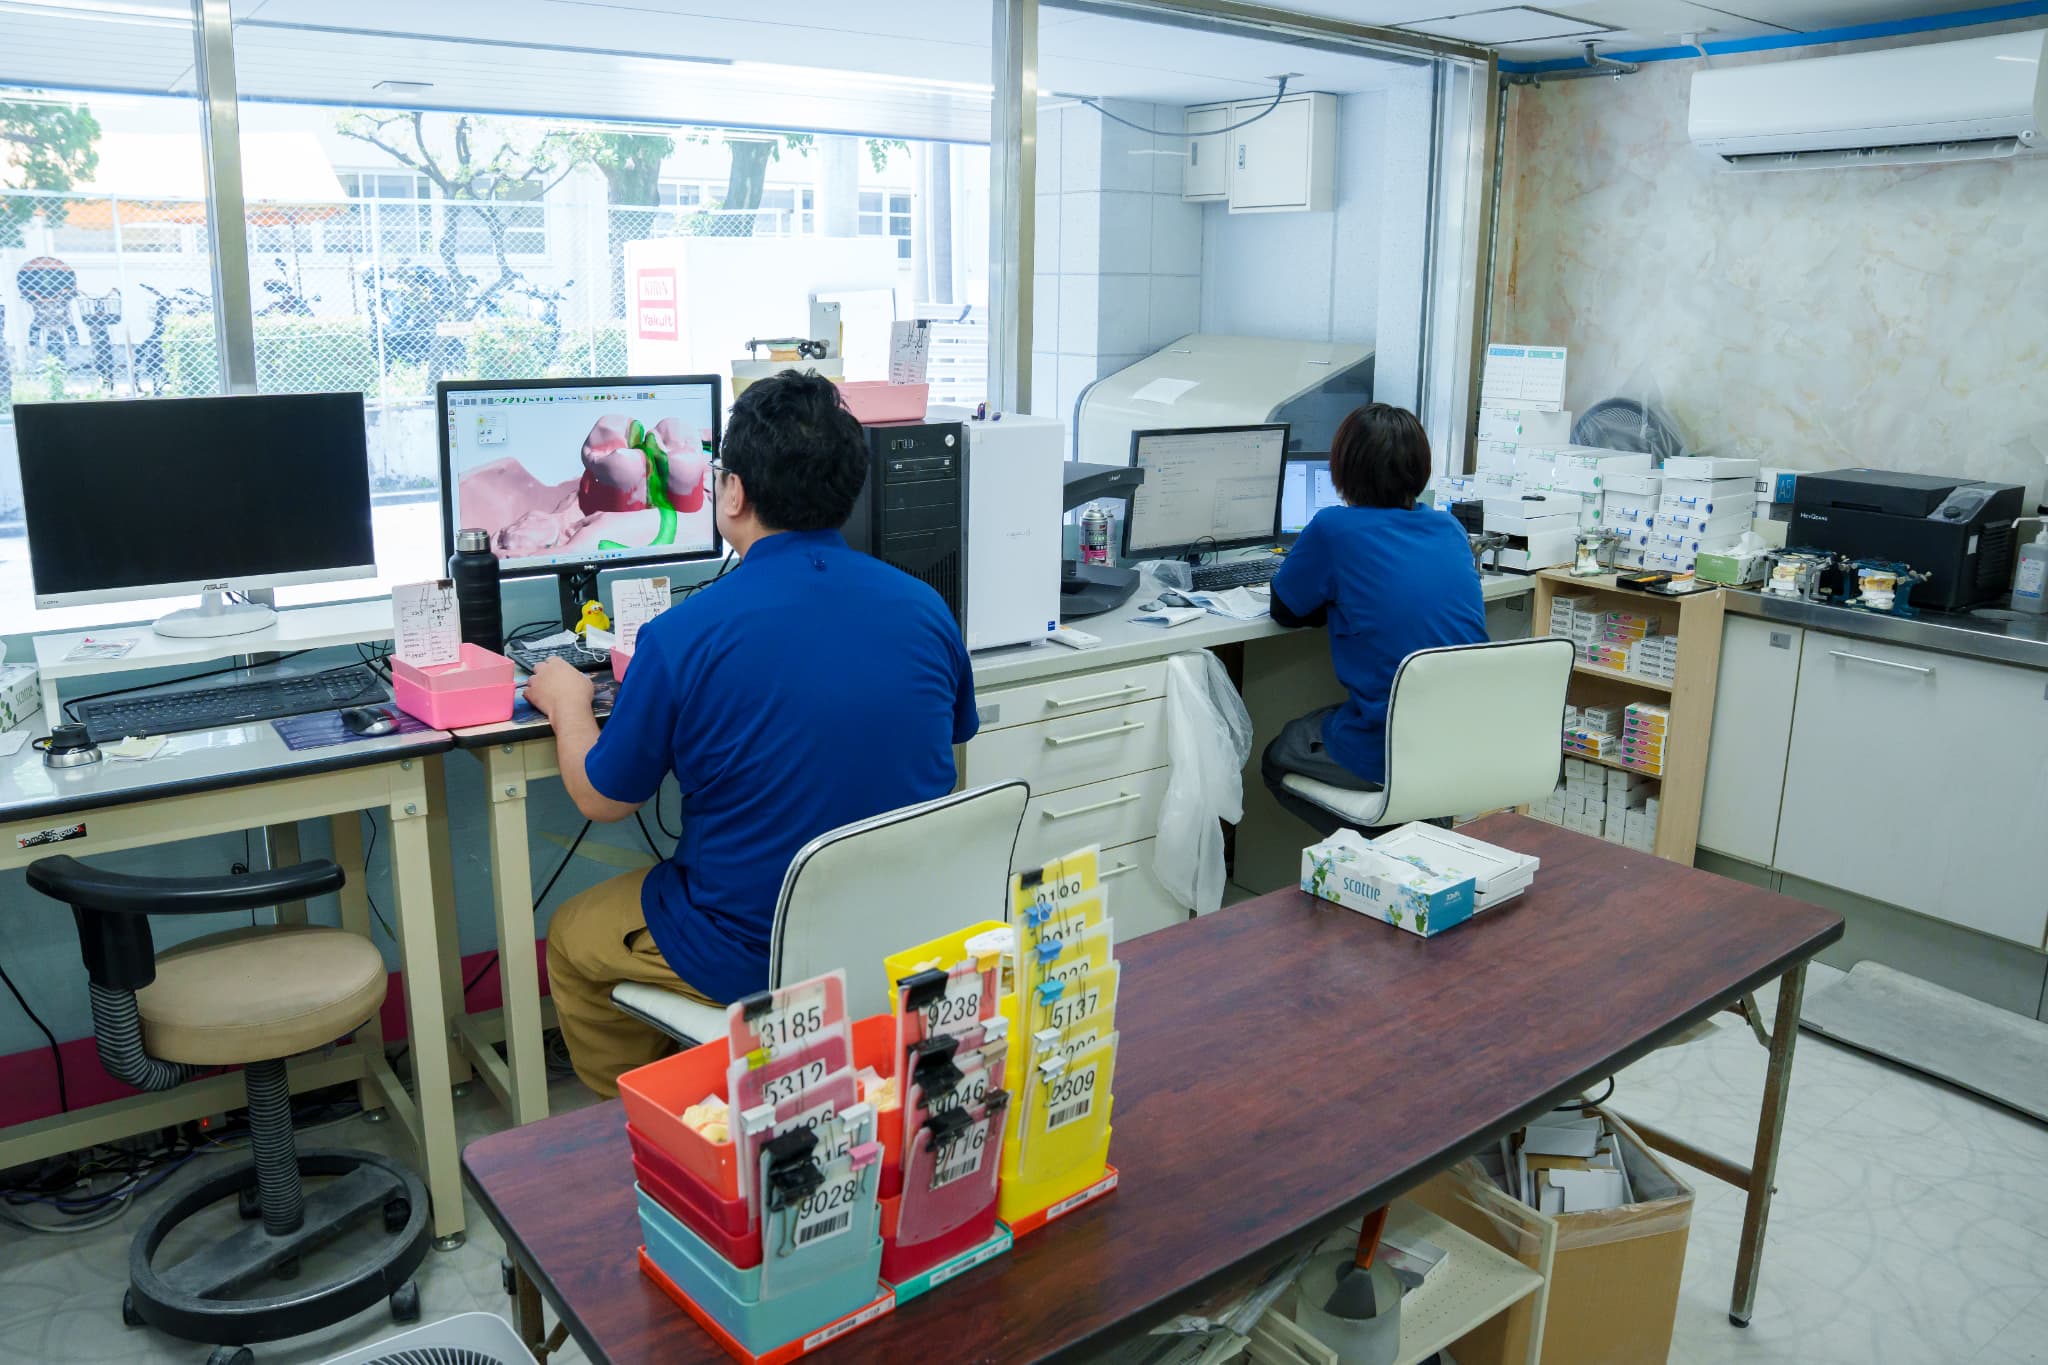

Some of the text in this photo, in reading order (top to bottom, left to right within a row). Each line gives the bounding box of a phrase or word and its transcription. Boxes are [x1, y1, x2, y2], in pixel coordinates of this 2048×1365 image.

[643, 312, 673, 328] Yakult
[203, 582, 229, 591] ASUS
[761, 1006, 821, 1049] 3185
[927, 993, 978, 1029] 9238
[1052, 993, 1098, 1029] 5137
[800, 1179, 856, 1220] 9028
